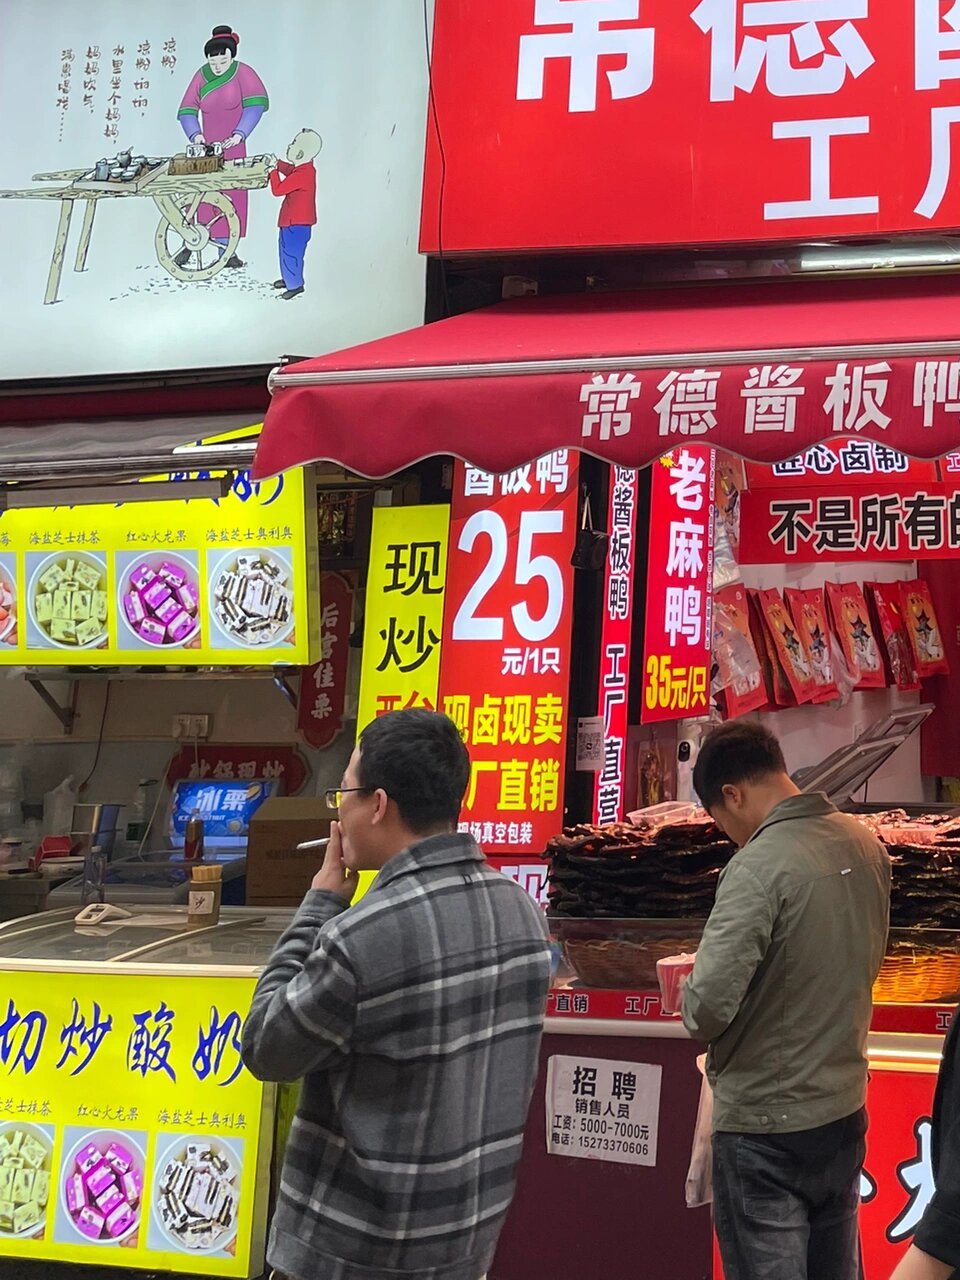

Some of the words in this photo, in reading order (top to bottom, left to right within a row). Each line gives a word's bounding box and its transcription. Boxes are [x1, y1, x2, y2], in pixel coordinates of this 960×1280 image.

[206, 526, 293, 542] 海盐芝士奥利奥
[664, 450, 707, 647] 老麻鸭
[452, 509, 564, 642] 25
[502, 647, 560, 676] 元/1只
[645, 654, 707, 711] 35元/只
[444, 693, 563, 745] 现卤现卖
[461, 758, 560, 812] 厂直销
[549, 994, 588, 1012] 直销
[625, 996, 674, 1016] 工厂
[0, 998, 245, 1086] 切炒酸奶
[572, 1066, 636, 1100] 招聘
[158, 1108, 247, 1129] 海盐芝士奥利奥
[575, 1098, 629, 1119] 销售人员
